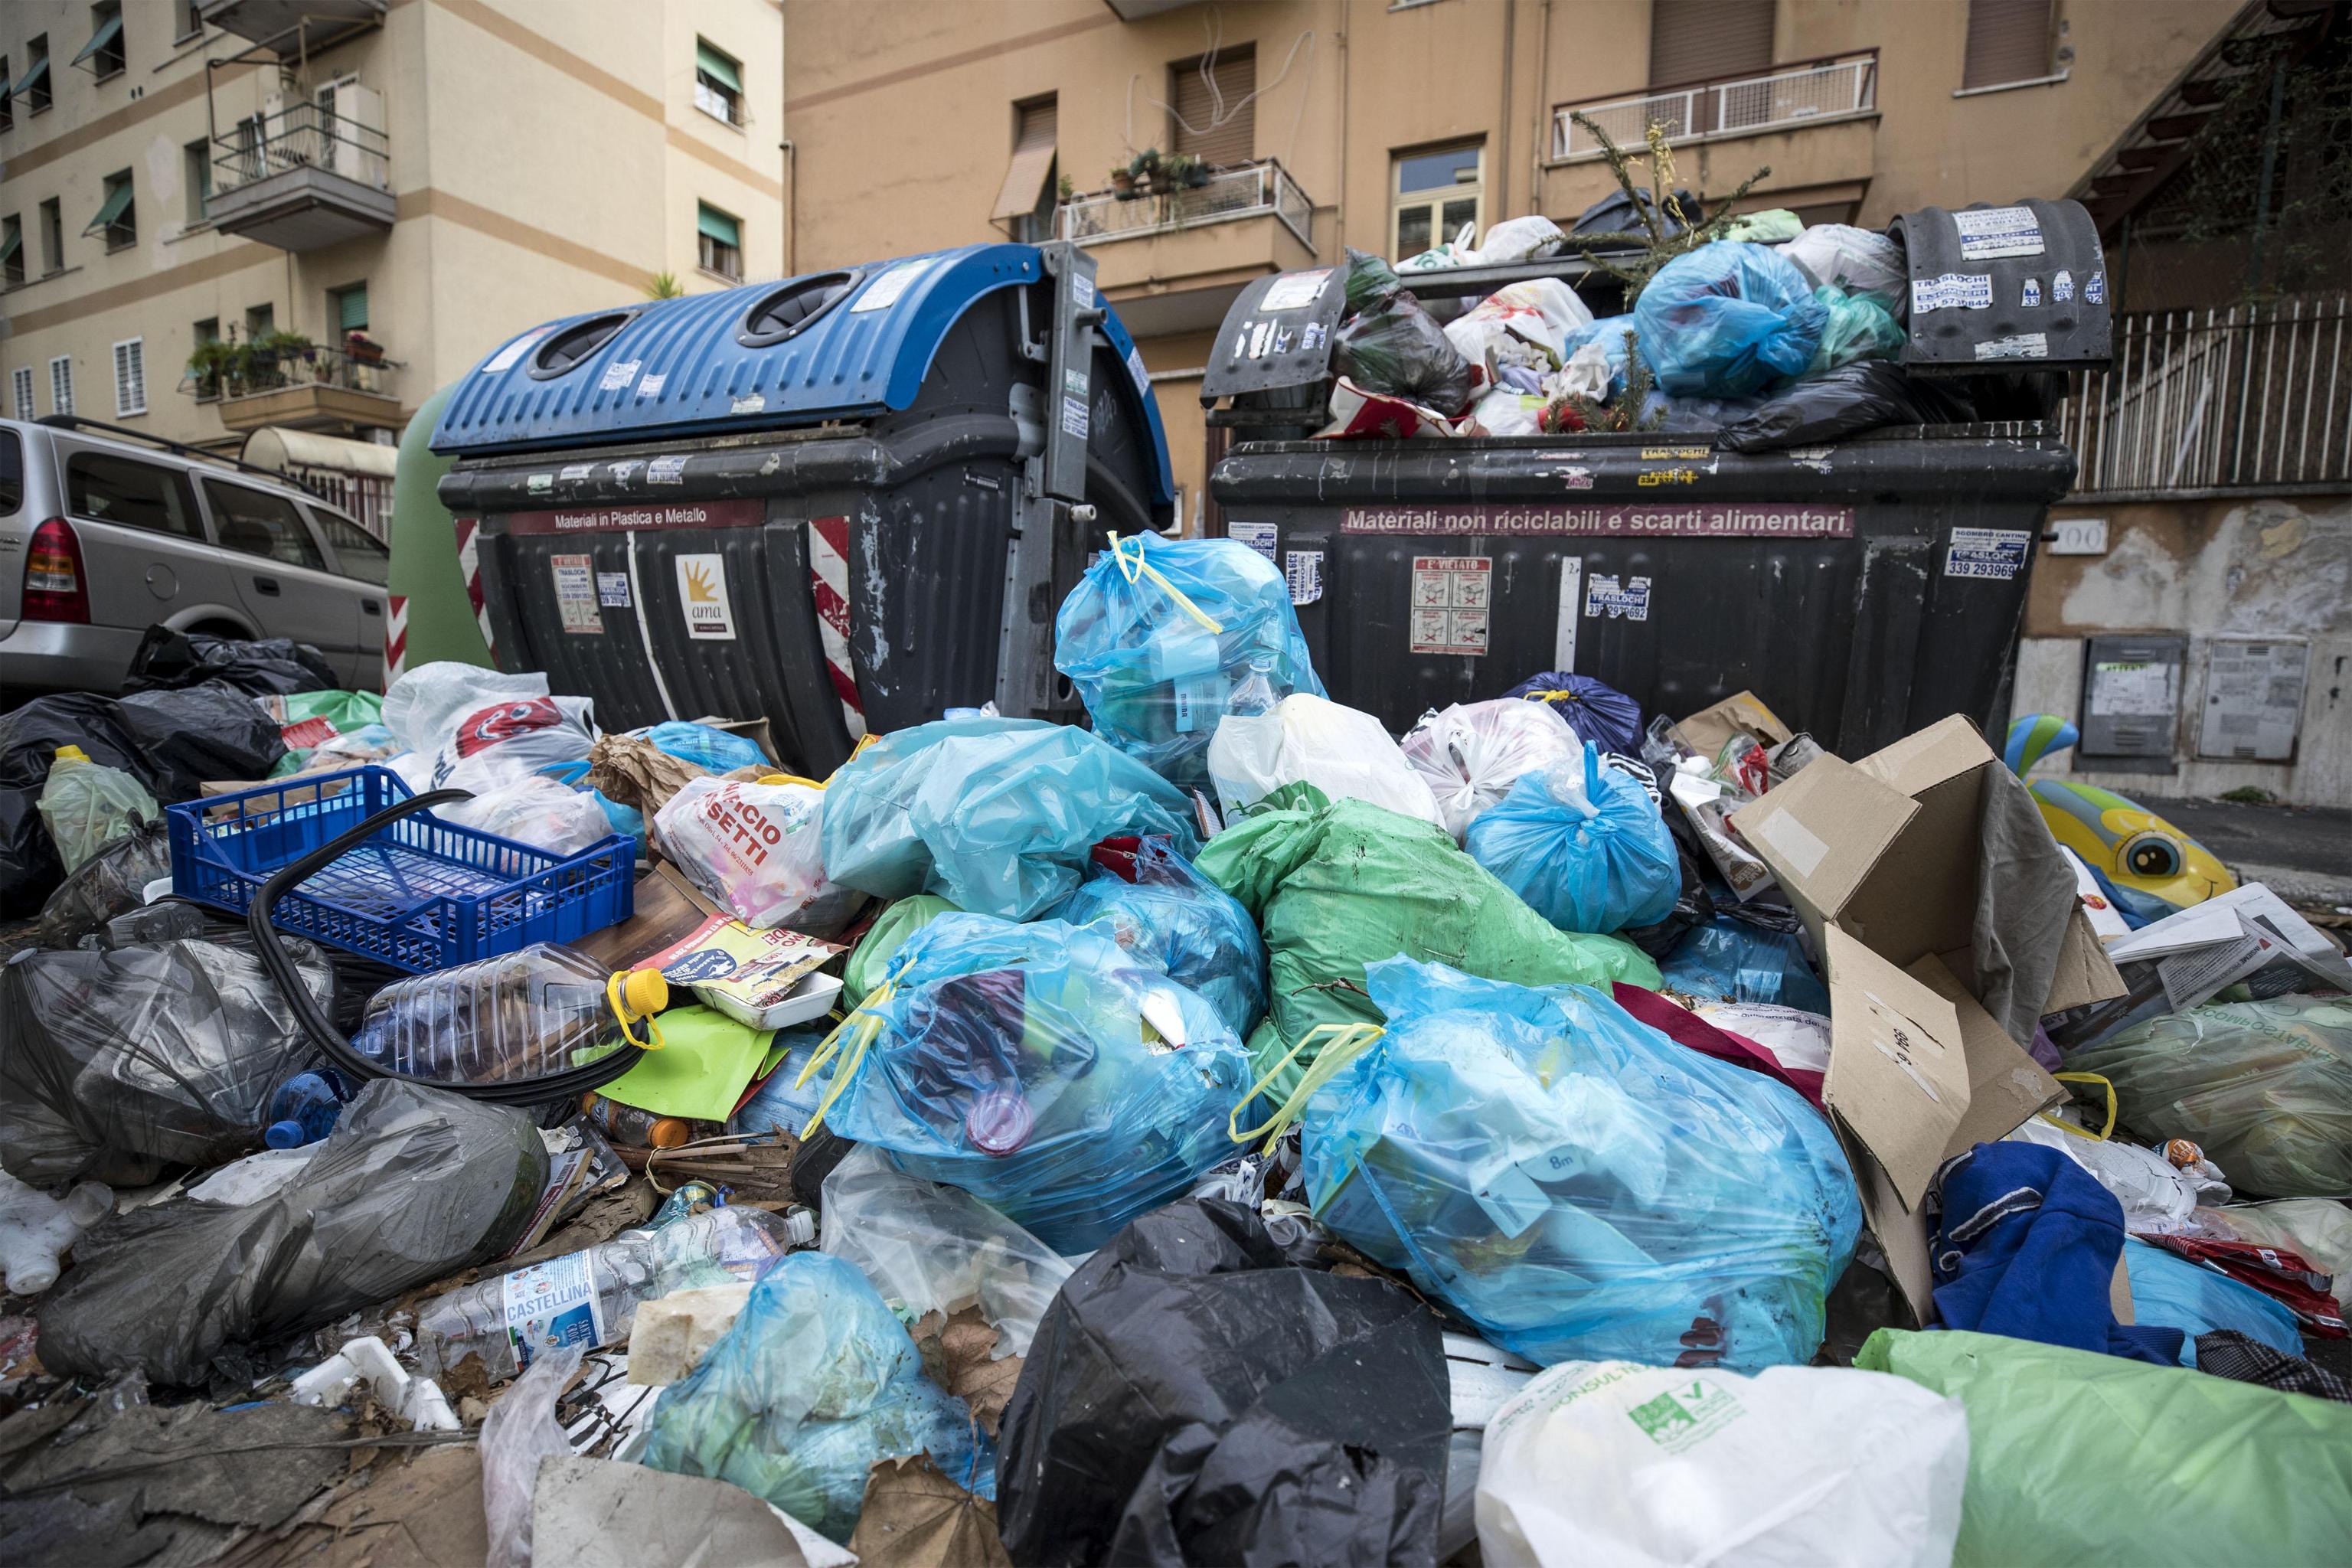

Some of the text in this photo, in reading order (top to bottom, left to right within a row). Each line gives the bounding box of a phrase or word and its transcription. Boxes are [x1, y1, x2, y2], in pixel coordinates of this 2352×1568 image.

[1916, 275, 1988, 288] TRASLOCHI
[555, 508, 707, 529] Materiali in Plastica e Metallo
[1348, 510, 1438, 530] Materiali
[1444, 514, 1487, 530] non
[1494, 510, 1601, 531] riciclabili
[1608, 514, 1622, 530] e
[1630, 510, 1701, 530] scarti
[1288, 553, 1298, 568] 339
[1956, 550, 2017, 563] TRASLOC
[1439, 560, 1478, 570] VIETATO
[1949, 562, 2016, 577] 339 293969
[1593, 593, 1645, 604] TRASLOCHI
[692, 606, 721, 619] ama
[2240, 946, 2262, 965] INSIEME
[507, 1281, 593, 1321] CASTELLINA
